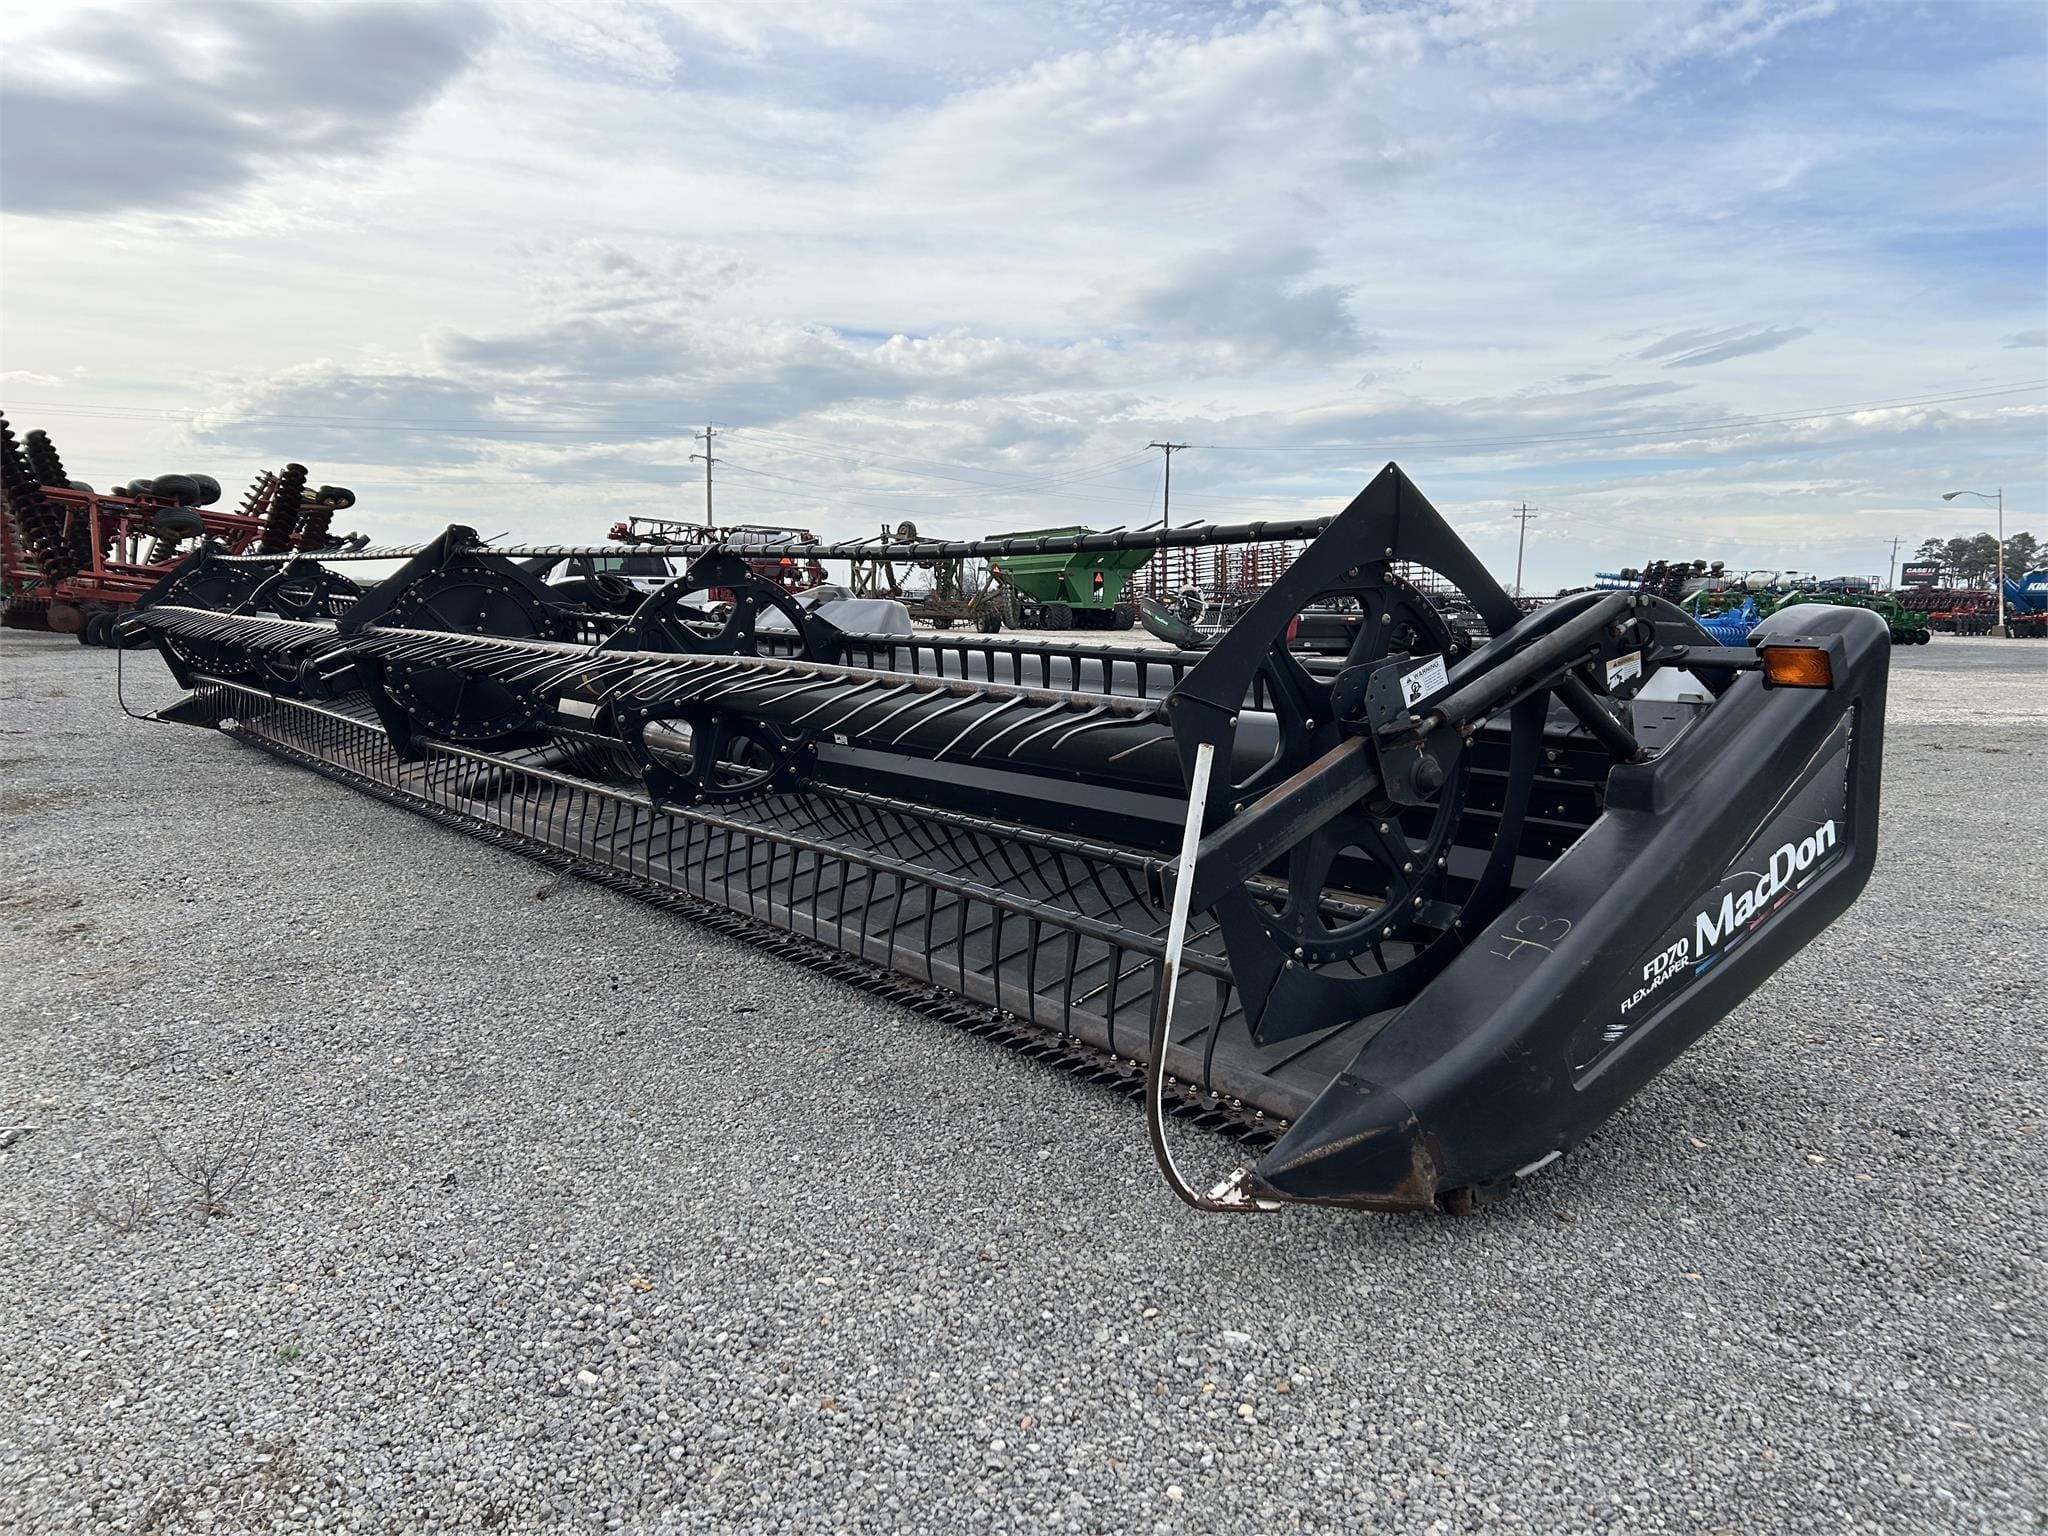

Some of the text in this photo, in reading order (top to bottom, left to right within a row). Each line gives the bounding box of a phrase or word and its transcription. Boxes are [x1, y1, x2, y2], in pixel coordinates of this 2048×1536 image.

[2027, 582, 2048, 591] KIN
[1412, 661, 1439, 679] WARNING
[1695, 819, 1836, 956] MacDon
[1643, 937, 1689, 981] FD70
